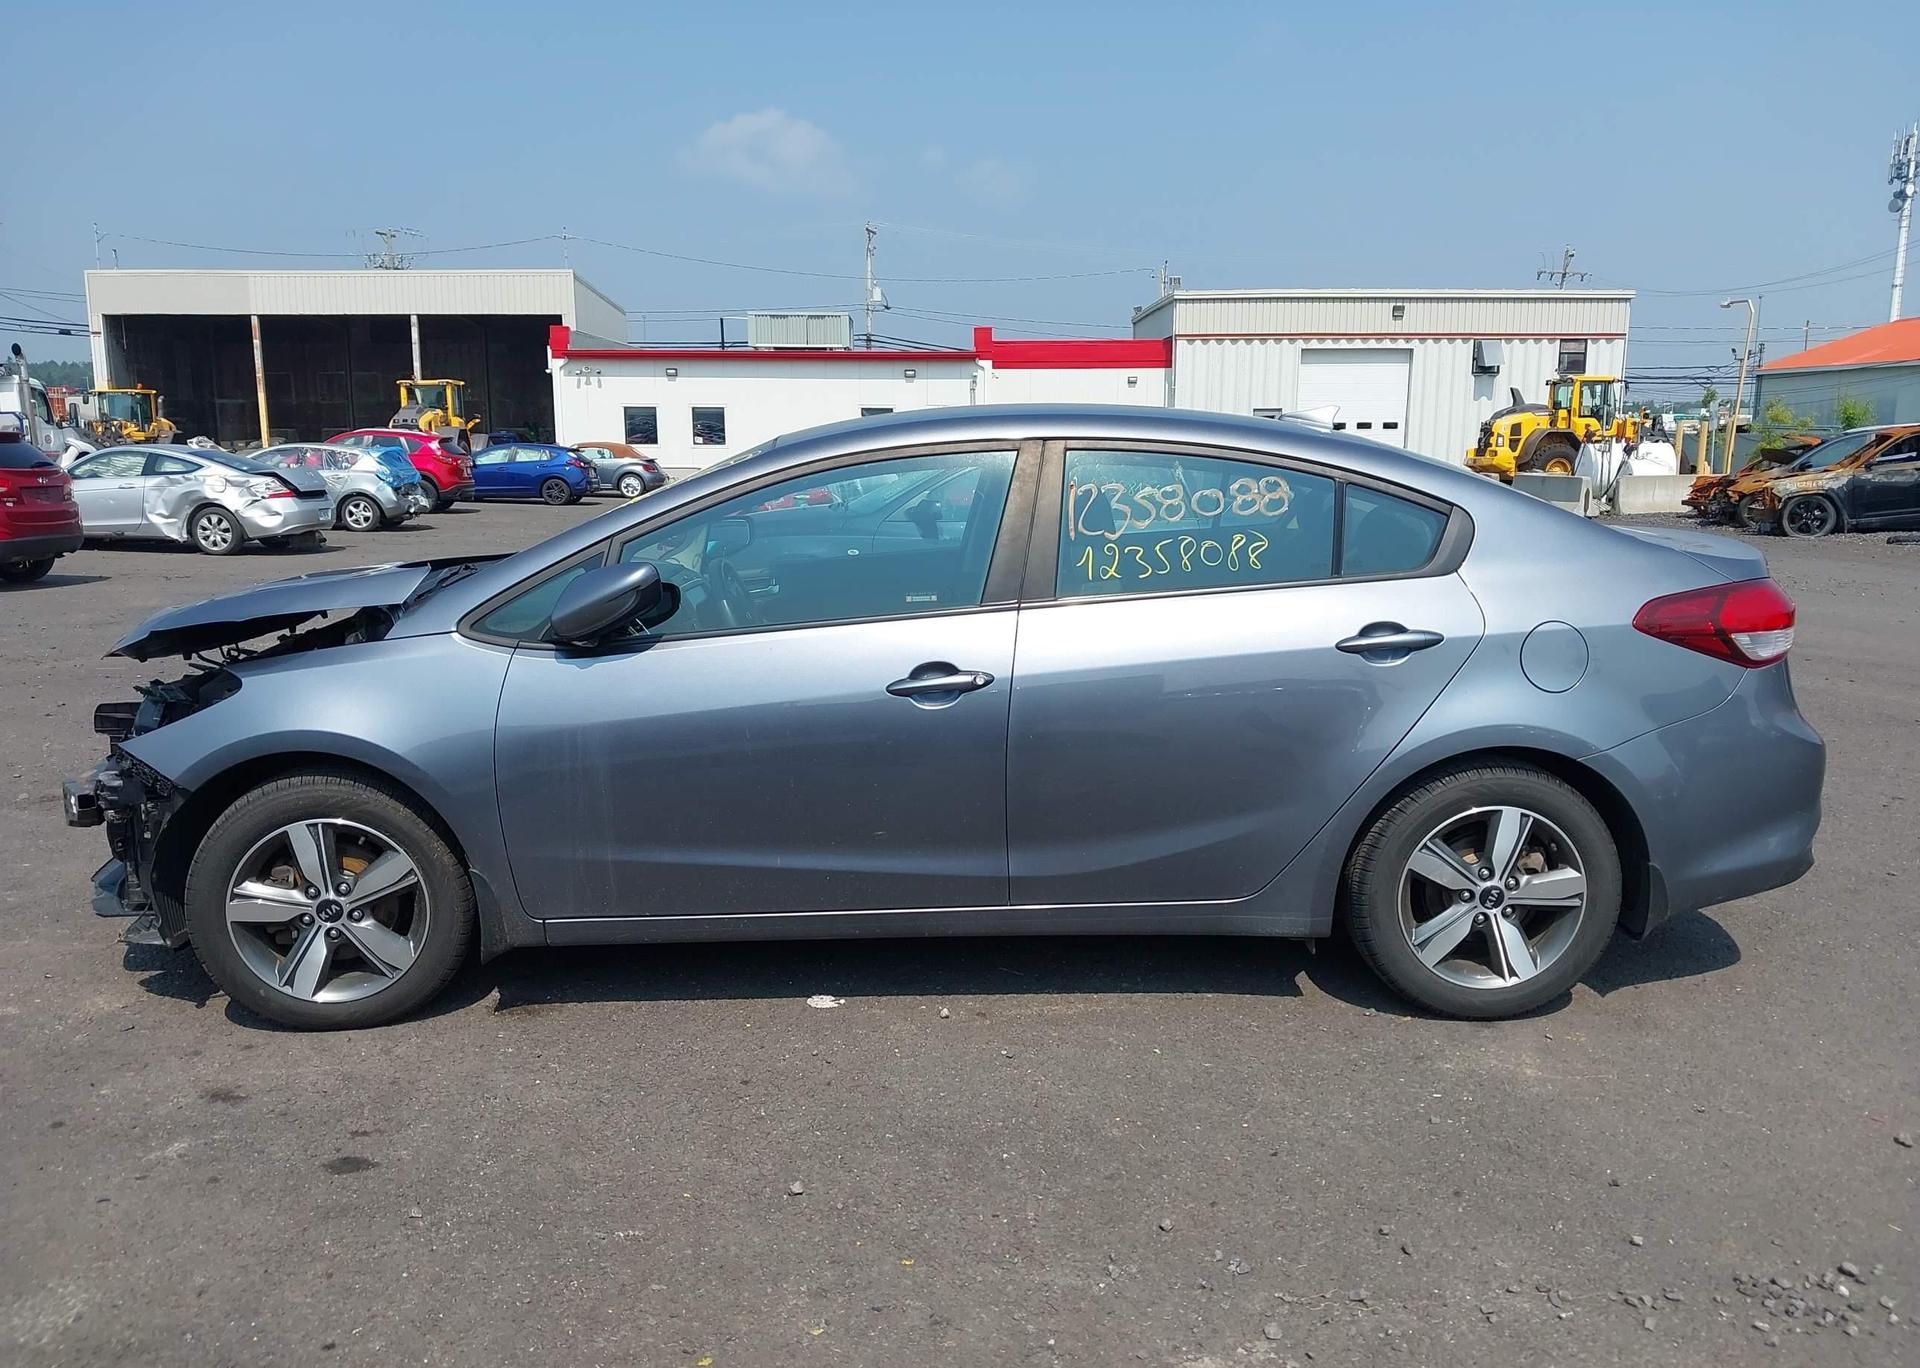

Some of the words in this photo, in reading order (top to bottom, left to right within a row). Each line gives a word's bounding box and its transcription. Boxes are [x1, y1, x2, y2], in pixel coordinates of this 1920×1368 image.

[1068, 476, 1292, 541] 12358088
[1076, 530, 1268, 580] 12358088
[319, 904, 340, 920] KIA
[1484, 890, 1500, 908] KIA
